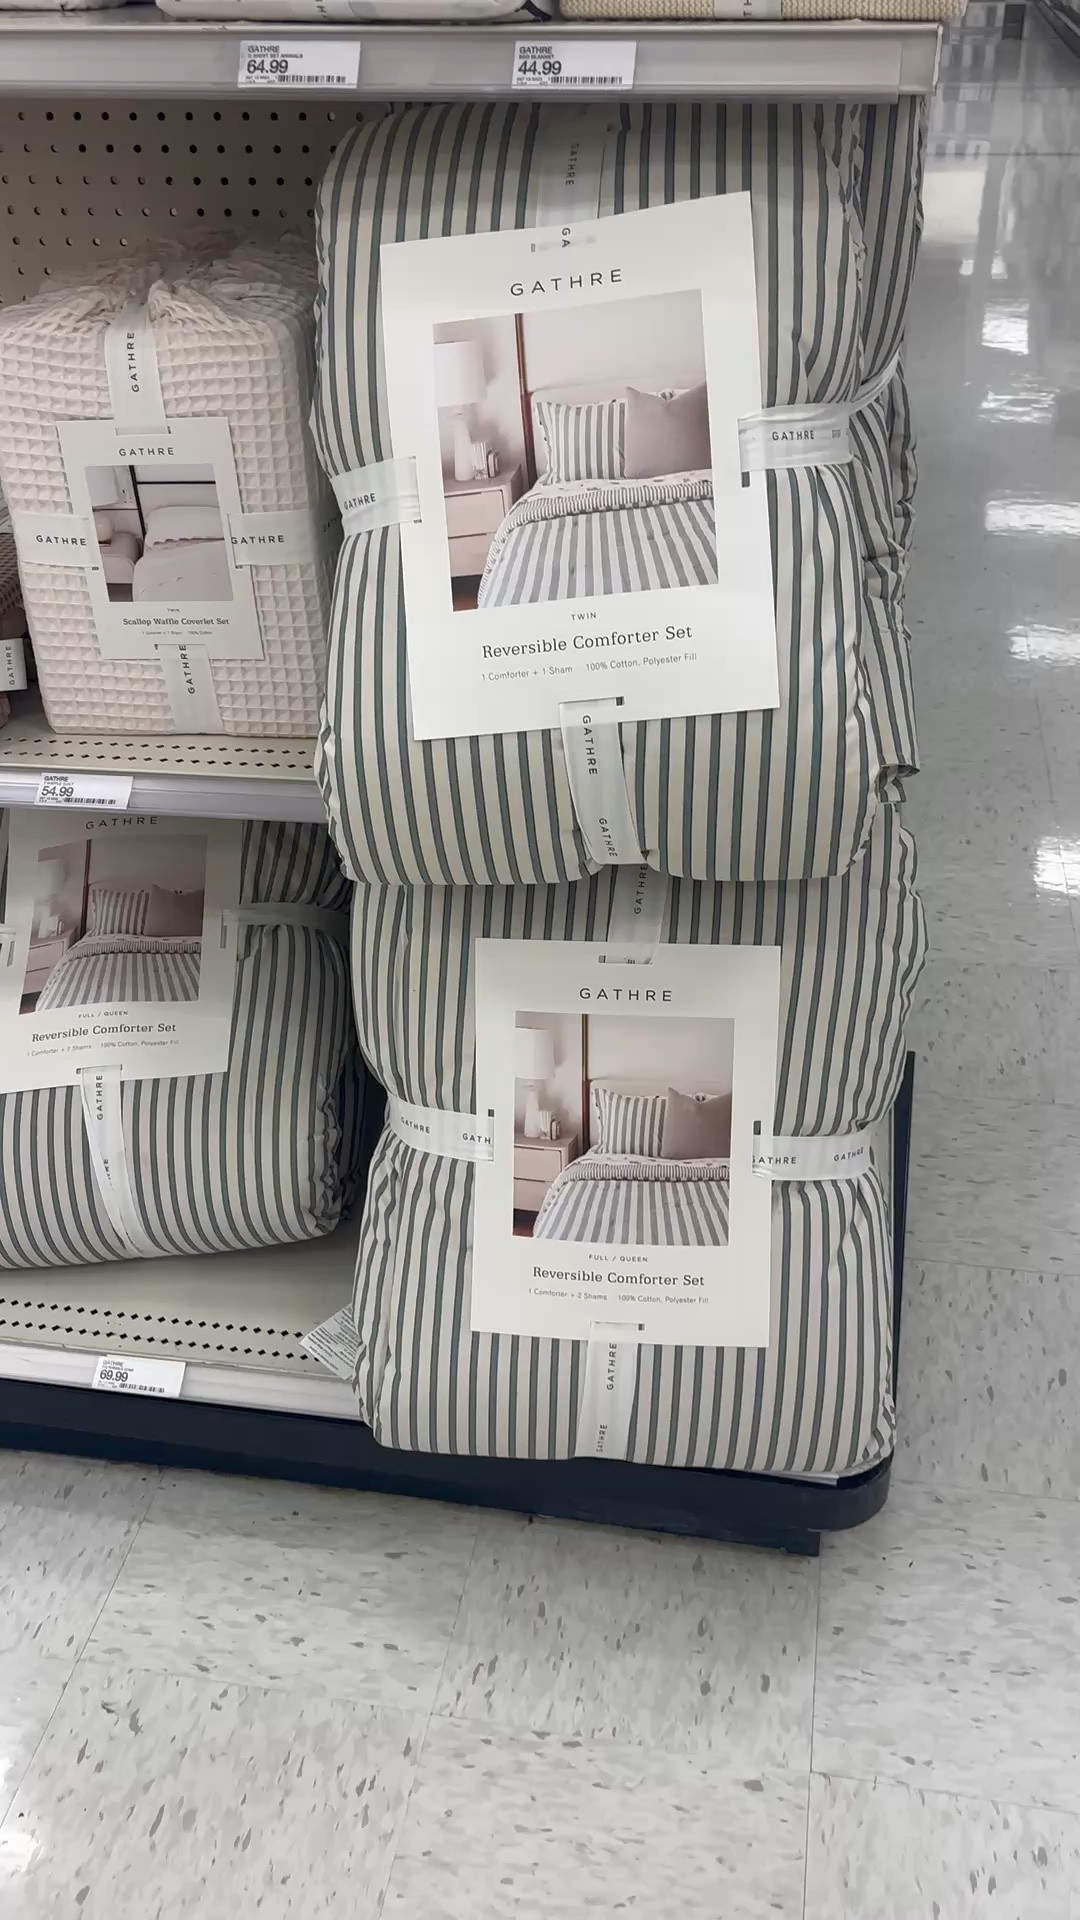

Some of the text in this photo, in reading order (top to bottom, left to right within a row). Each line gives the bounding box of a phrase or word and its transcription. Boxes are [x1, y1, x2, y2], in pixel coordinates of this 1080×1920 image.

[248, 45, 280, 53] GATHRE
[519, 46, 552, 54] GATHRE
[247, 59, 289, 74] 64.99
[517, 60, 562, 76] 44.99
[566, 143, 580, 186] GATHRE
[510, 268, 623, 297] GATHRE
[126, 331, 140, 393] GATHRE
[771, 429, 815, 442] GATHRE
[118, 447, 175, 457] GATHRE
[343, 492, 377, 511] GATHRE
[36, 534, 88, 547] GATHRE
[231, 534, 286, 545] GATHRE
[122, 617, 230, 627] Scallop Waffle Coverlet Set
[570, 611, 598, 622] TWIN
[482, 624, 694, 660] Reversible Comforter Set
[5, 645, 16, 686] GATHRE
[178, 643, 196, 695] GATHRE
[585, 661, 608, 672] 100%
[642, 653, 682, 667] Polyester
[684, 652, 698, 662] Fill
[481, 673, 486, 682] 1
[488, 669, 530, 682] Comforter
[542, 667, 547, 675] 1
[549, 664, 573, 676] Sham
[581, 714, 598, 776] GATHRE
[41, 785, 74, 797] 54.99
[86, 816, 159, 830] GATHRE
[598, 817, 619, 858] GATHRE
[633, 863, 649, 915] GATHRE
[579, 987, 673, 1002] GATHRE
[31, 1022, 177, 1043] Reversible Comforter Set
[100, 1041, 117, 1049] 100%
[95, 1074, 104, 1121] GATHRE
[400, 1116, 431, 1134] GATHRE
[462, 1132, 491, 1145] GATH
[833, 1146, 865, 1162] GATHRE
[588, 1253, 609, 1262] FULL
[619, 1255, 649, 1263] QUEEN
[532, 1266, 705, 1286] Reversible Comforter Set
[533, 1287, 568, 1298] Comforter
[577, 1291, 582, 1299] 2
[583, 1291, 608, 1301] Shams
[617, 1294, 637, 1302] 100%
[664, 1295, 697, 1305] Polyester
[698, 1296, 709, 1304] Fill
[606, 1342, 617, 1391] GATHRE
[99, 1368, 129, 1383] 69.99
